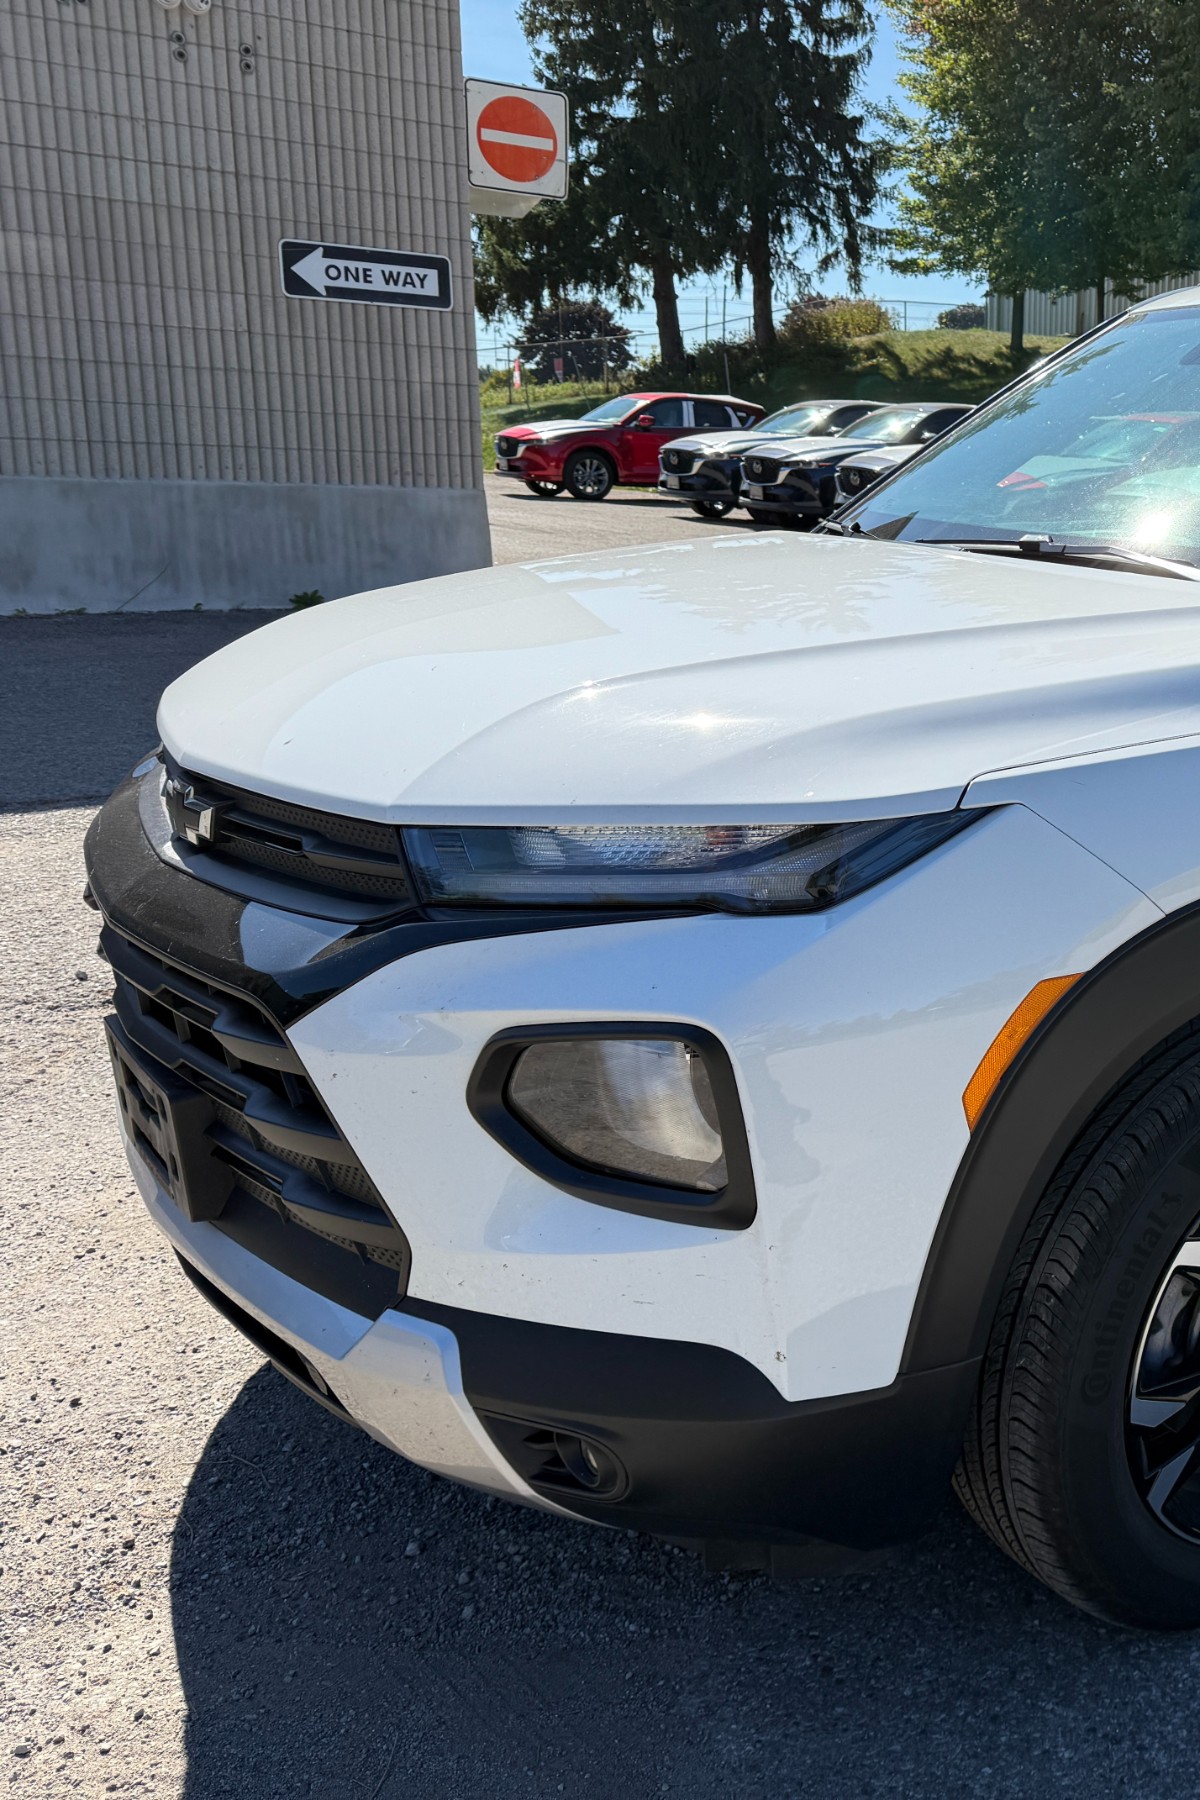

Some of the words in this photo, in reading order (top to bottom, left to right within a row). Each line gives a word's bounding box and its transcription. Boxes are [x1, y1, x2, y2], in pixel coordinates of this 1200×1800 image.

[324, 264, 373, 284] ONE
[381, 269, 428, 289] WAY
[1080, 1209, 1170, 1407] Continental
